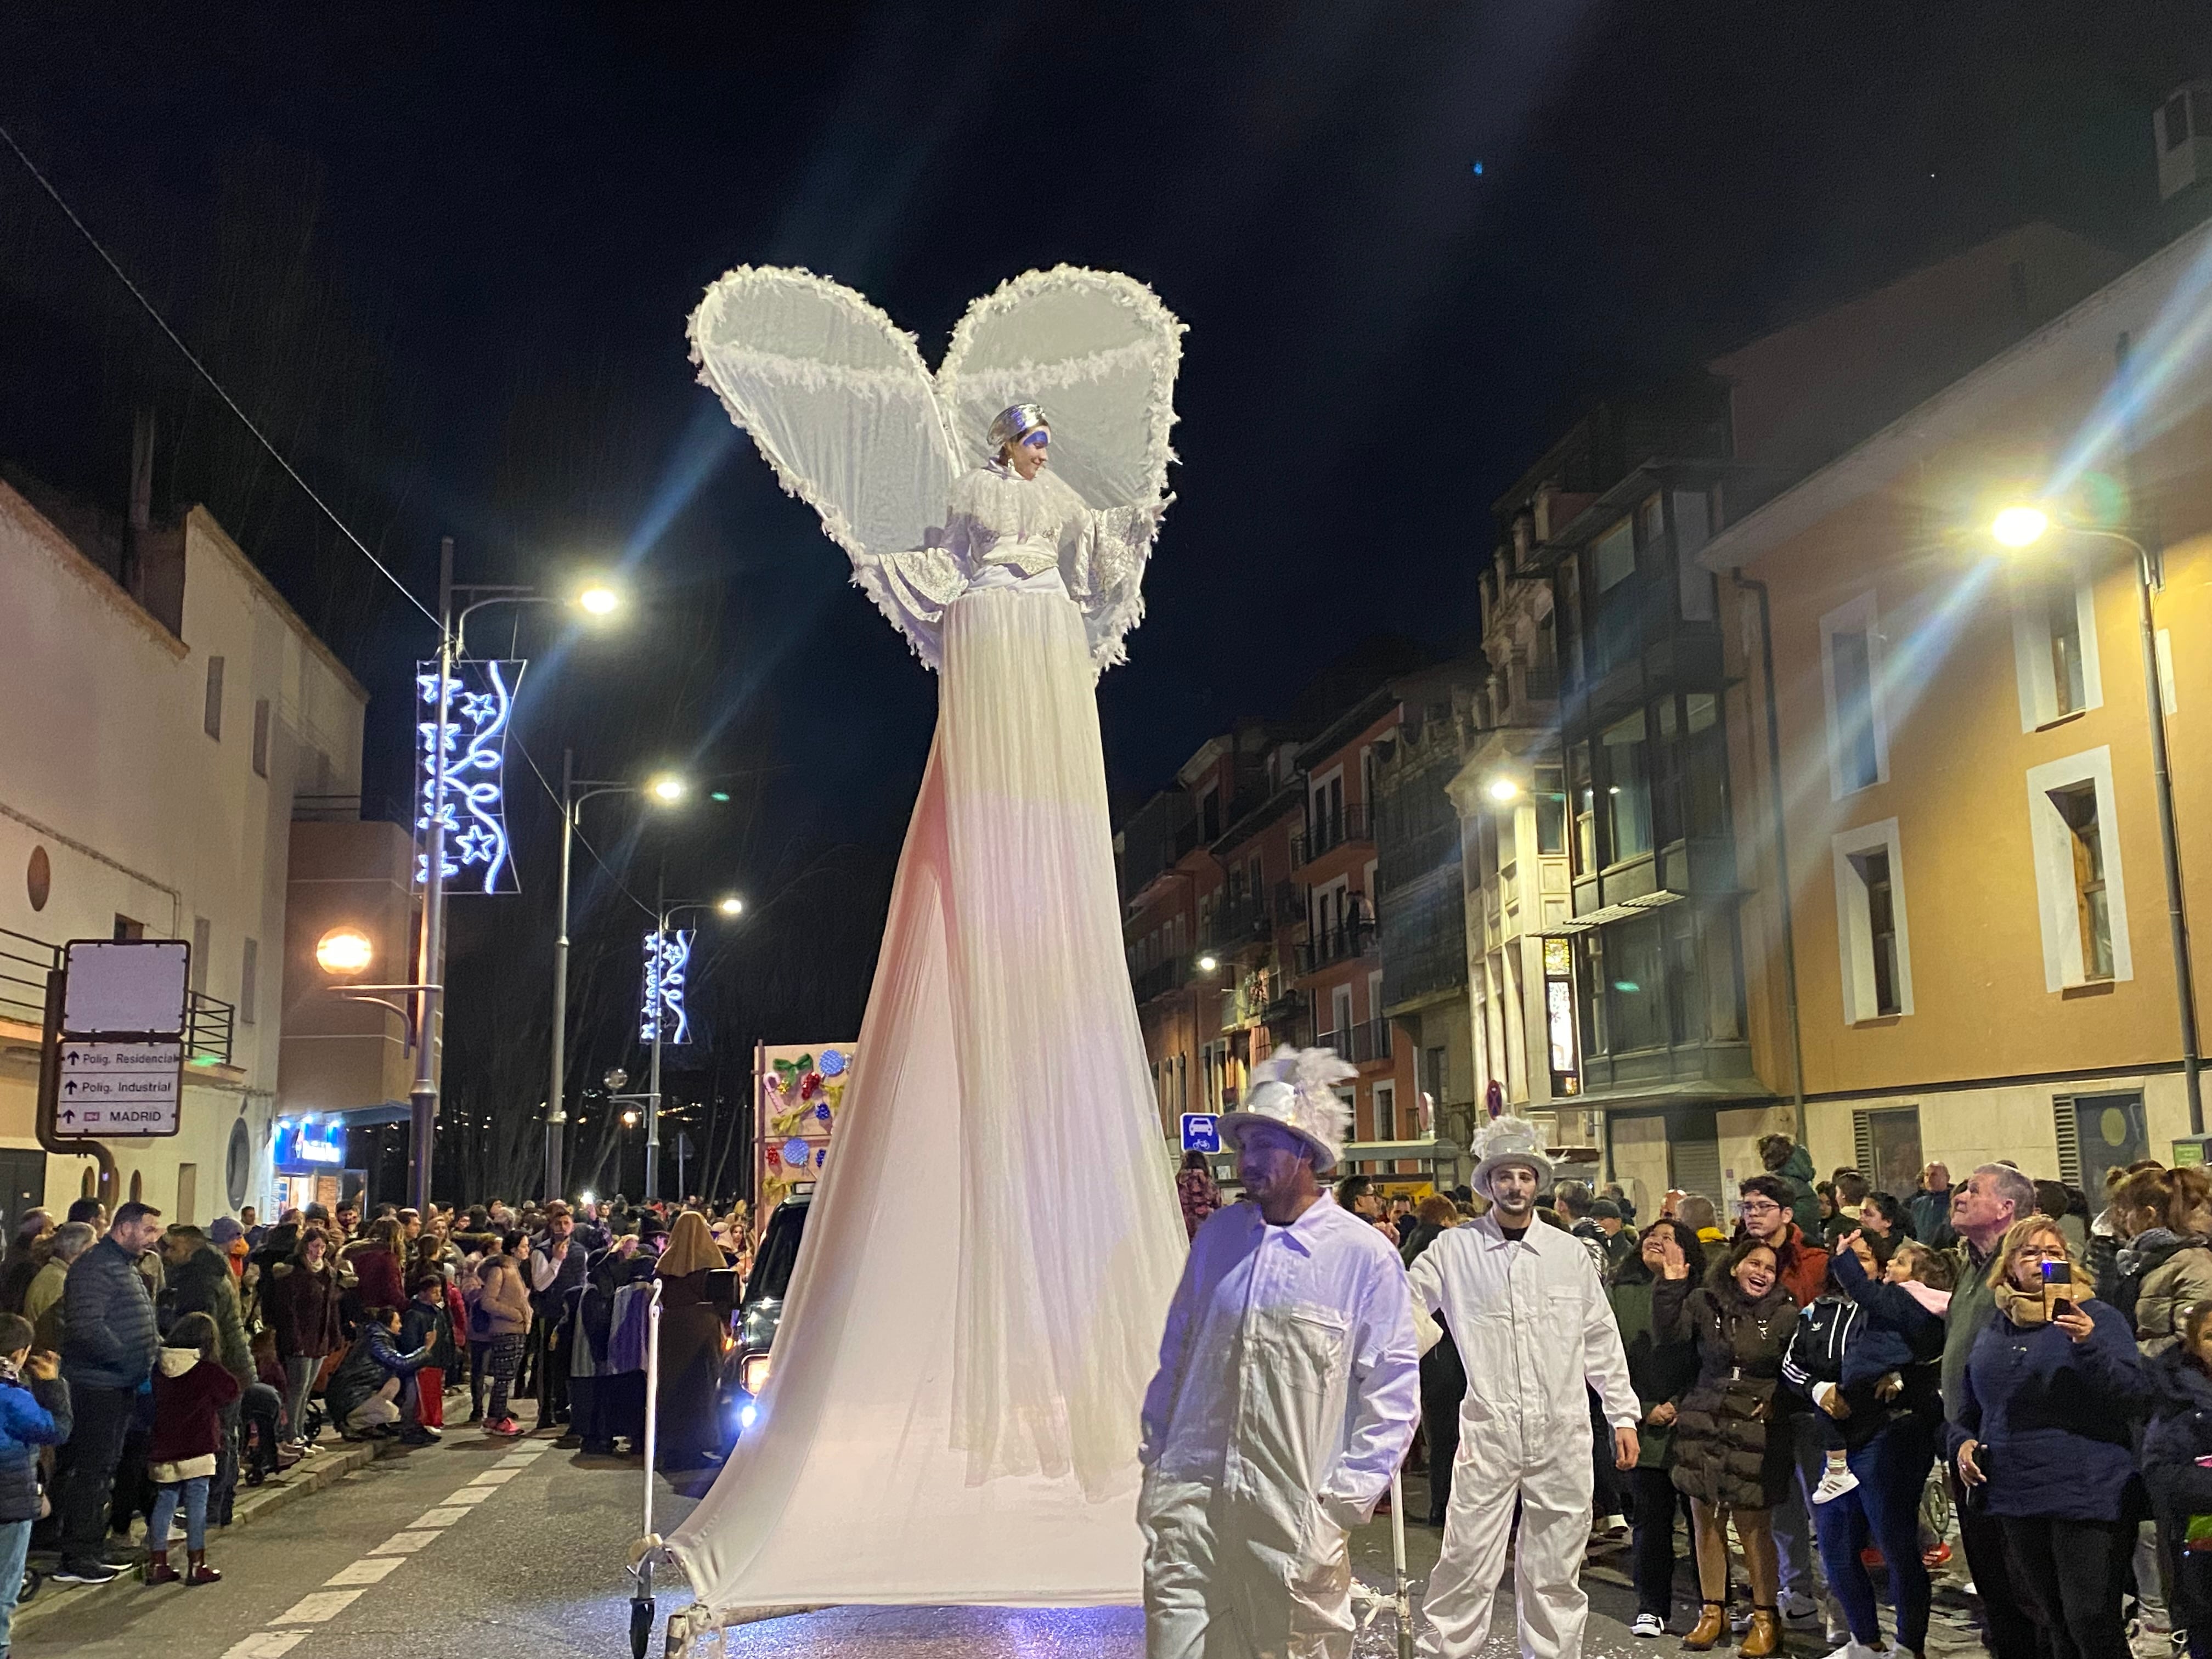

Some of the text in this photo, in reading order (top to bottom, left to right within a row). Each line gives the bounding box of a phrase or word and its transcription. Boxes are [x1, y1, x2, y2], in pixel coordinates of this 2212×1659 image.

[116, 1053, 177, 1063] Residencial
[82, 1082, 171, 1094] Polig. Industrial
[110, 1111, 161, 1121] MADRID
